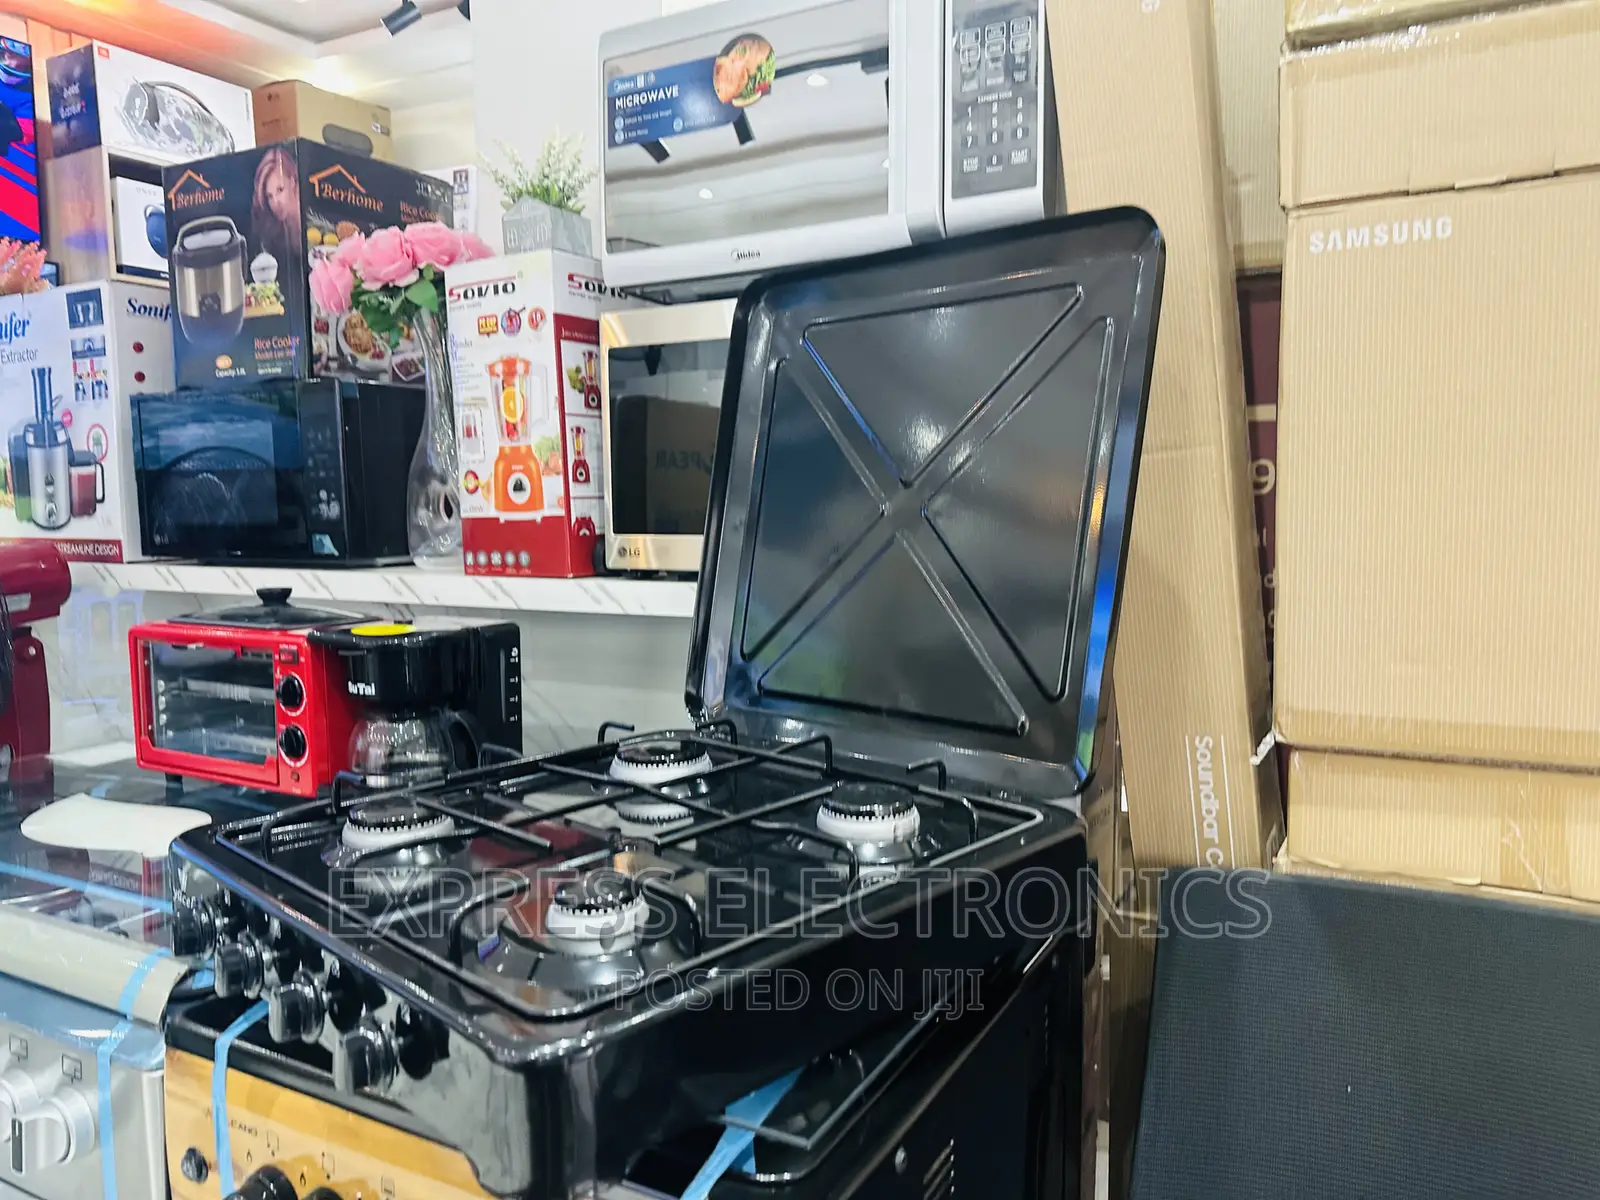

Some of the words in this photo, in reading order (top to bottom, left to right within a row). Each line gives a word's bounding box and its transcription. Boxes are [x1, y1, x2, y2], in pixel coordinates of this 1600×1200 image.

[616, 85, 680, 110] MICROWAVE
[1309, 214, 1453, 254] SAMSUNG
[126, 297, 172, 322] Sonif
[1, 348, 39, 364] Extractor
[1194, 735, 1220, 844] Soundbar
[1205, 847, 1224, 868] C
